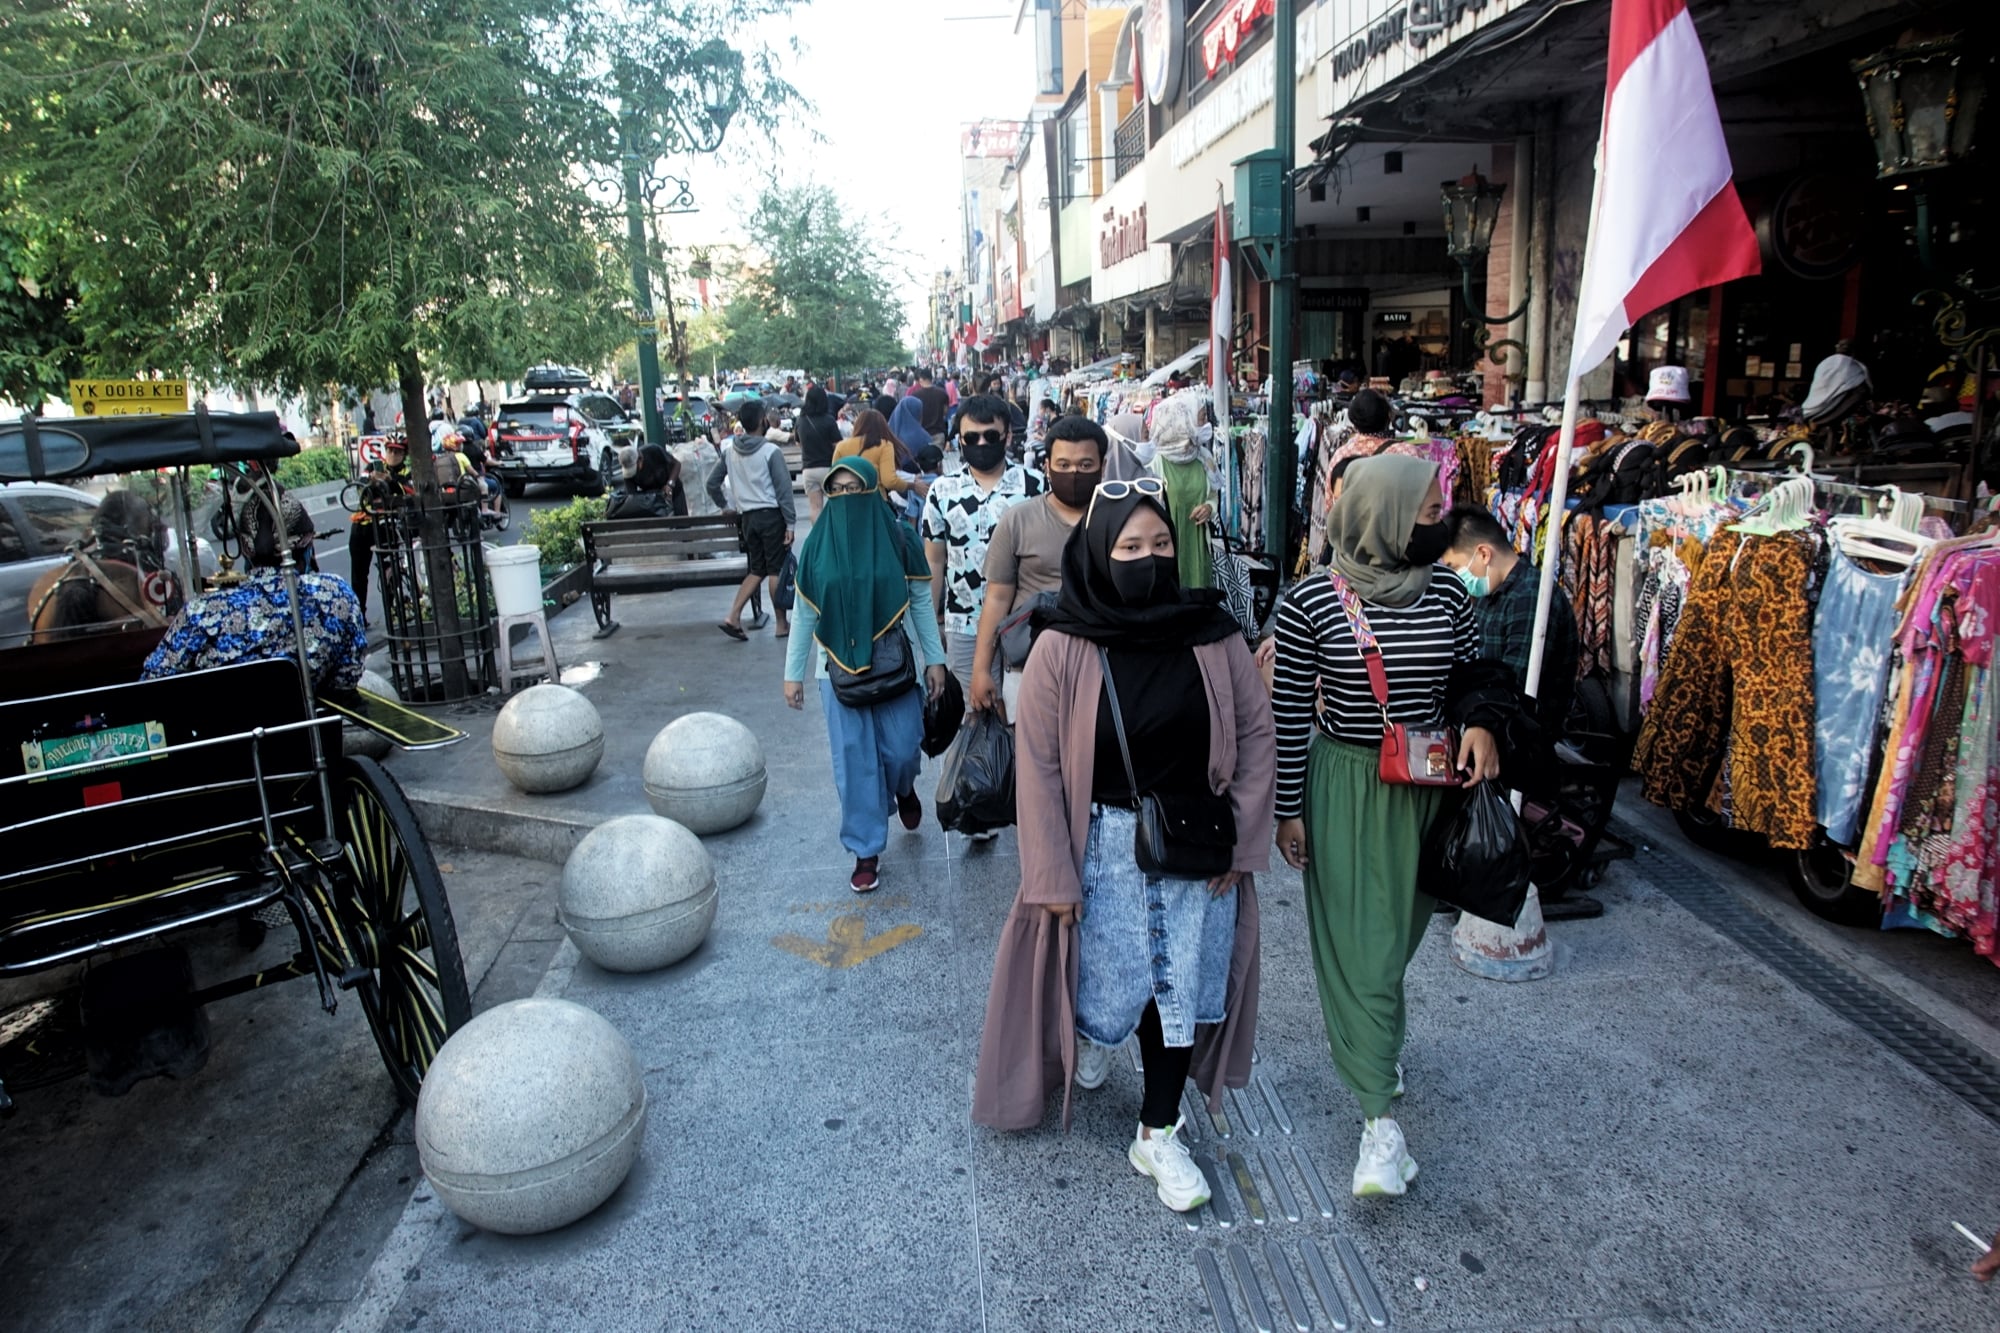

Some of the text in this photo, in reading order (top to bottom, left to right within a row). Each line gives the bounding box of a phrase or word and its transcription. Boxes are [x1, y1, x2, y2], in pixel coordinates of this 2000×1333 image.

[1331, 39, 1367, 82] TOKO
[1368, 7, 1407, 59] OBAT
[1196, 78, 1240, 149] GRILLING
[1240, 48, 1274, 117] SINCE
[75, 384, 184, 397] YK 0018 KTB
[137, 405, 152, 415] 23
